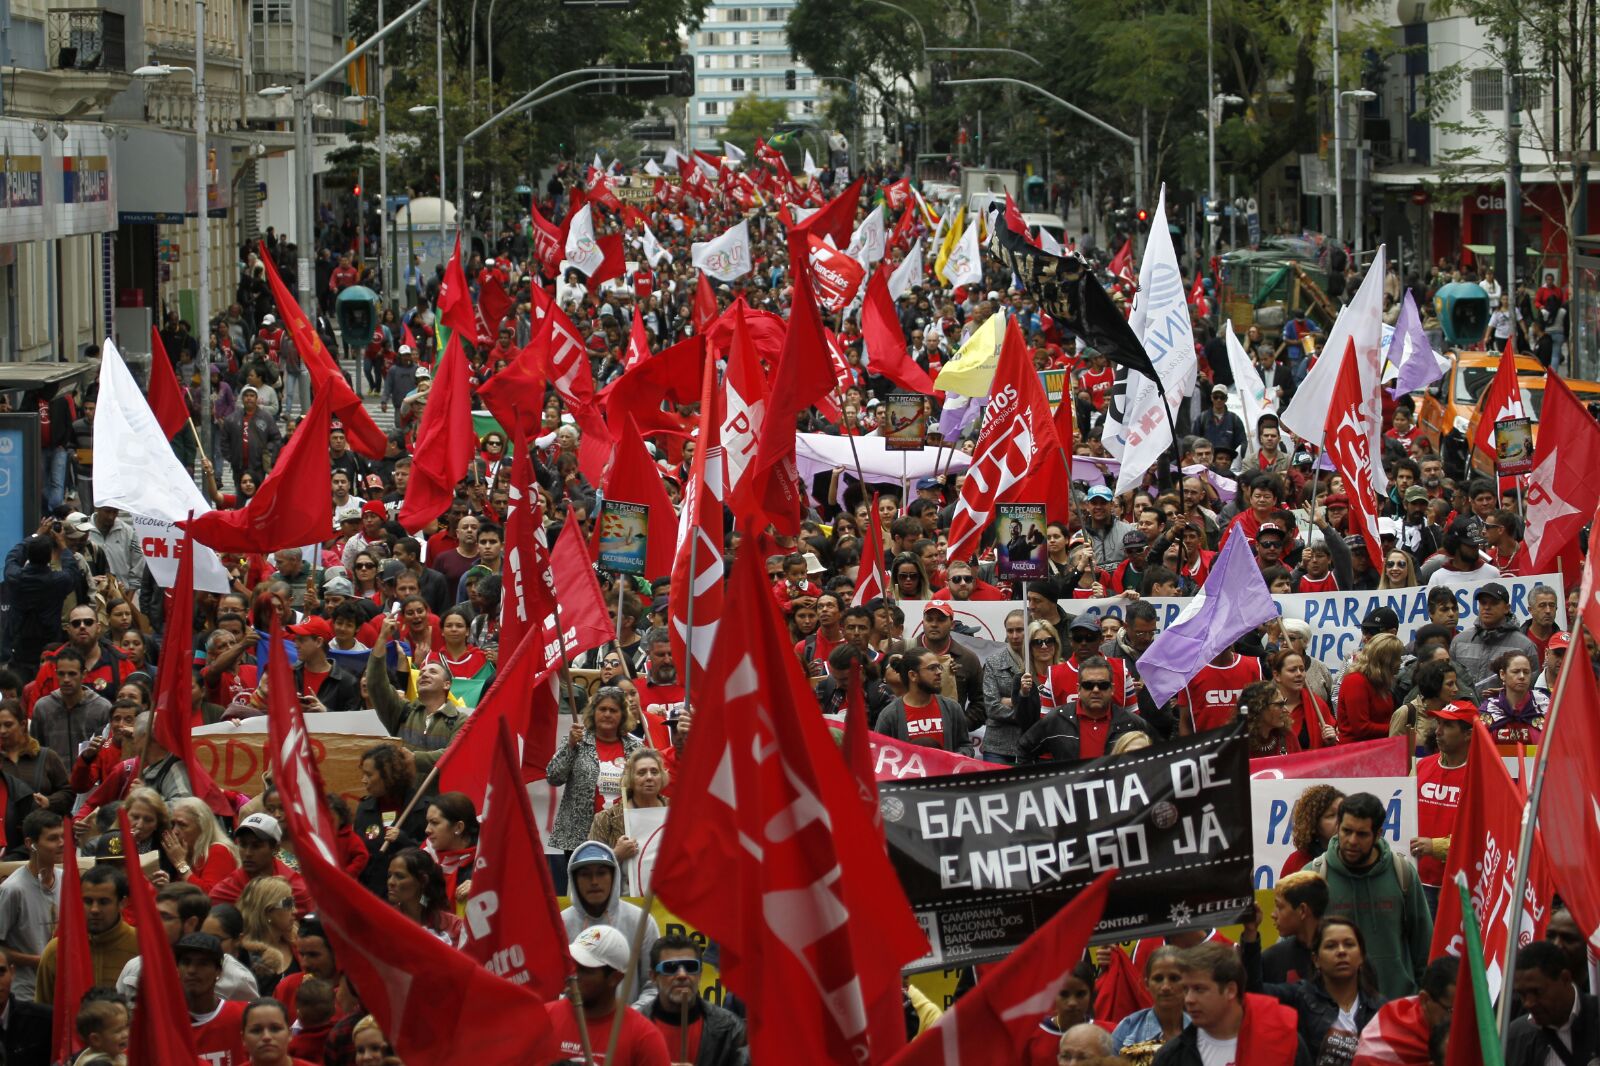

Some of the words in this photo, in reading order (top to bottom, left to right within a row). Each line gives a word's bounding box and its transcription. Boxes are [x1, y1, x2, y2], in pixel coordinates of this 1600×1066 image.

[1476, 195, 1507, 210] Cla
[1205, 689, 1243, 704] CUT
[906, 718, 944, 732] CUT
[917, 772, 1150, 840] GARANTIA
[1170, 752, 1232, 799] DE
[940, 823, 1149, 890] EMPREGO
[1173, 802, 1230, 855] JÁ
[941, 907, 1004, 924] CAMPANHA
[943, 918, 998, 934] NACIONAL
[1000, 915, 1023, 926] DOS
[944, 928, 1006, 945] BANCÁRIOS
[946, 944, 972, 957] 2015
[560, 1041, 581, 1051] MPM
